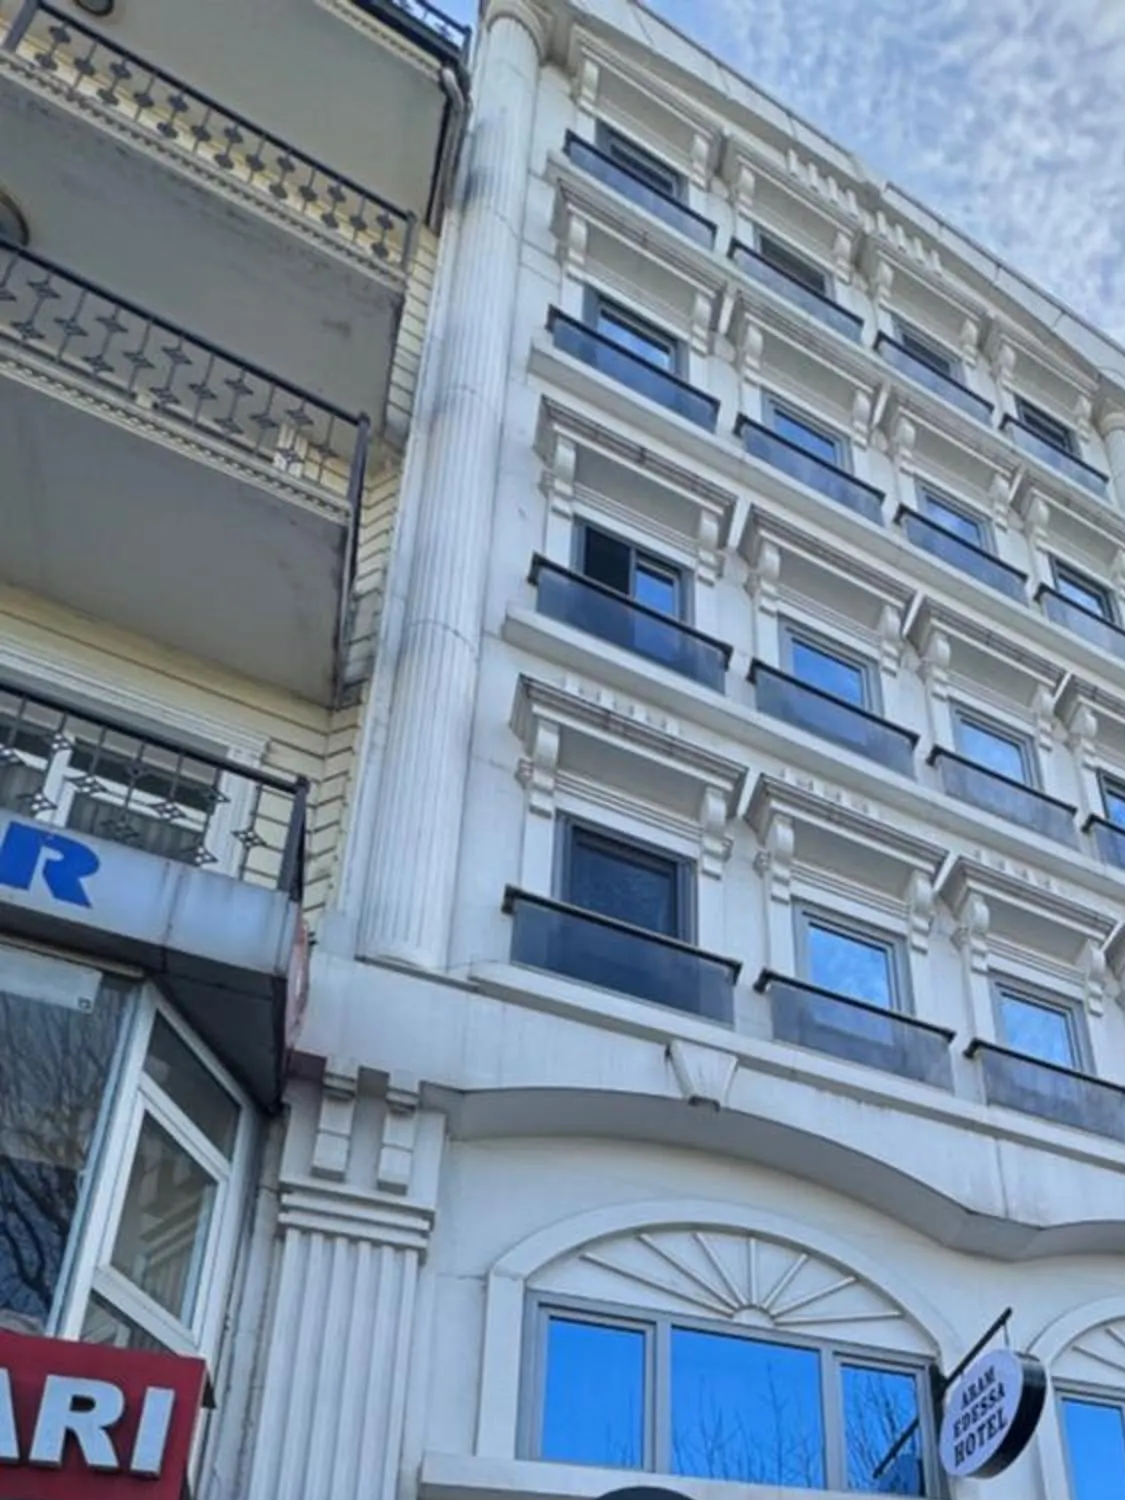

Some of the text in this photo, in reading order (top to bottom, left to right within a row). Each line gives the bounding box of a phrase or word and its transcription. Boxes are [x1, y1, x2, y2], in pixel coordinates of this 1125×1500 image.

[953, 1382, 1006, 1438] EDESSA
[961, 1364, 997, 1409] ARAM
[0, 1367, 175, 1478] RI
[954, 1406, 1008, 1468] HOTEL
